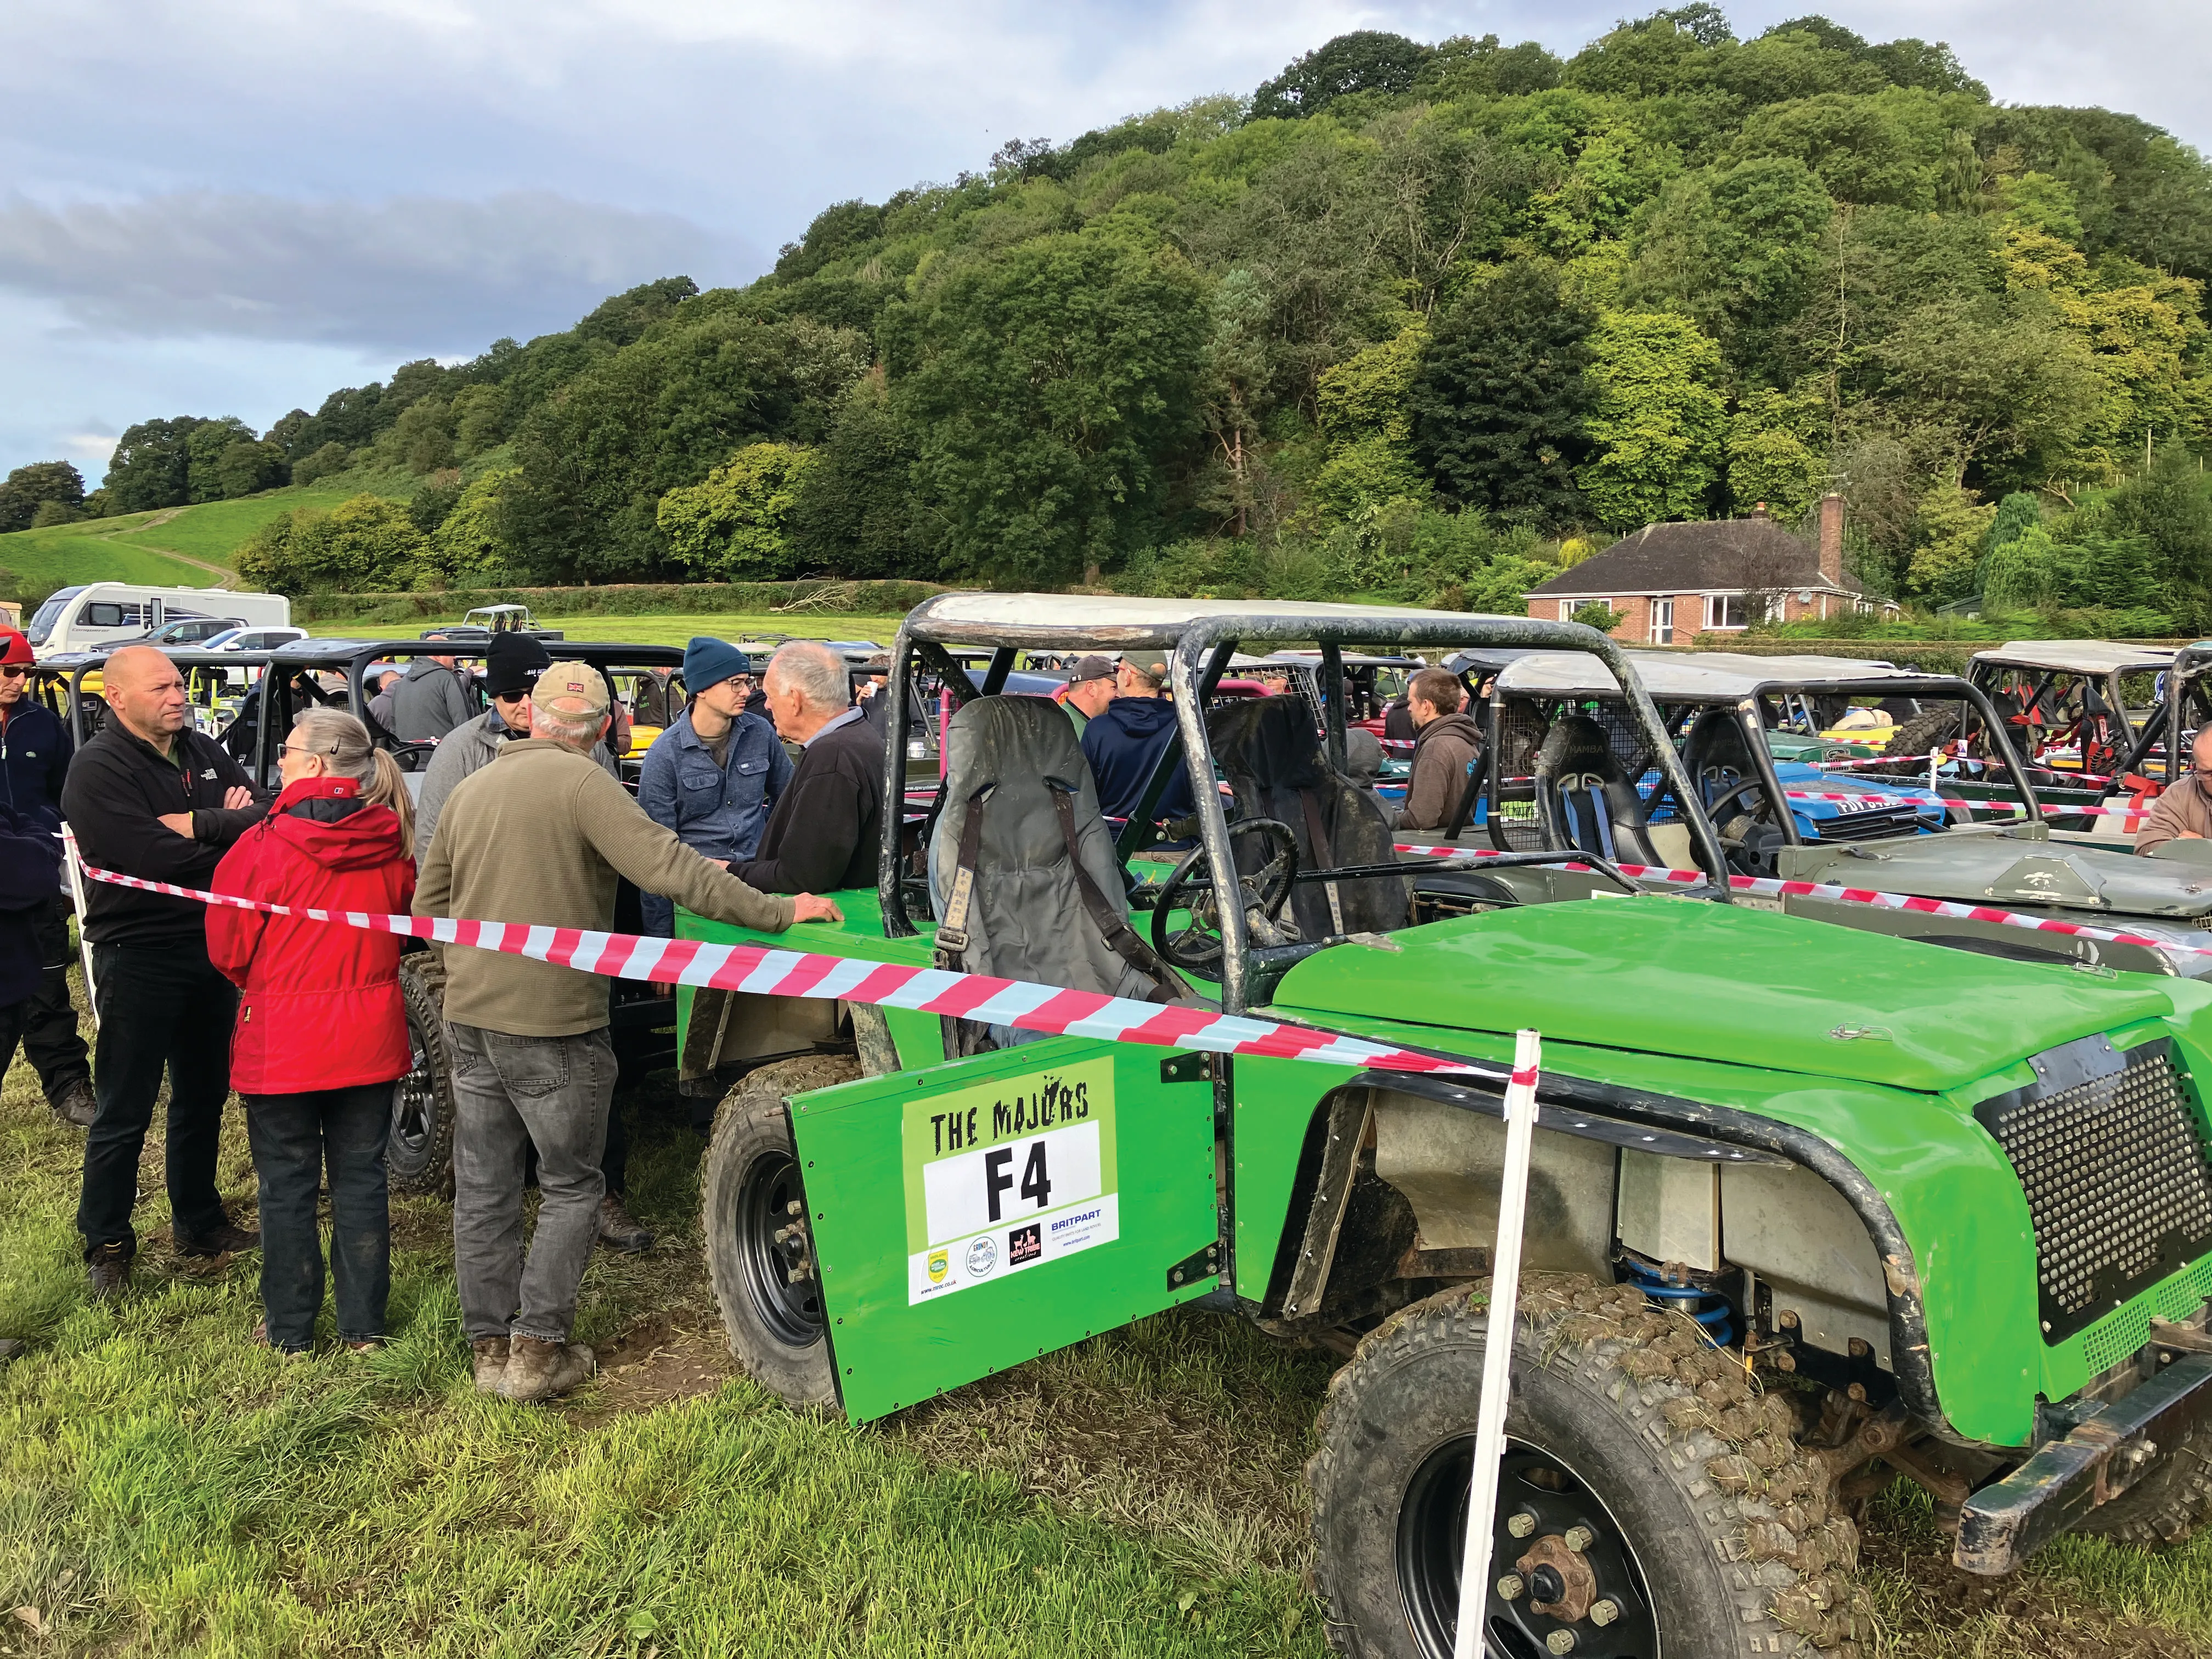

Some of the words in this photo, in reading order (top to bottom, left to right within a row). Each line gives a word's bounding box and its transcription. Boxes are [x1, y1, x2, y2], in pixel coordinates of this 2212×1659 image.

[1570, 745, 1604, 753] MAMBA
[930, 1107, 978, 1155] THE
[993, 1075, 1088, 1141] MAJORS
[985, 1141, 1051, 1222] F4
[1051, 1209, 1101, 1231] BRITPART
[1063, 1235, 1090, 1246] www.britpart.com
[1011, 1248, 1024, 1258] KEW
[1024, 1243, 1040, 1254] TRIBE
[1014, 1251, 1037, 1261] creations
[969, 1259, 994, 1273] AGRICULTURAL
[921, 1279, 957, 1295] www.mroc.co.uk
